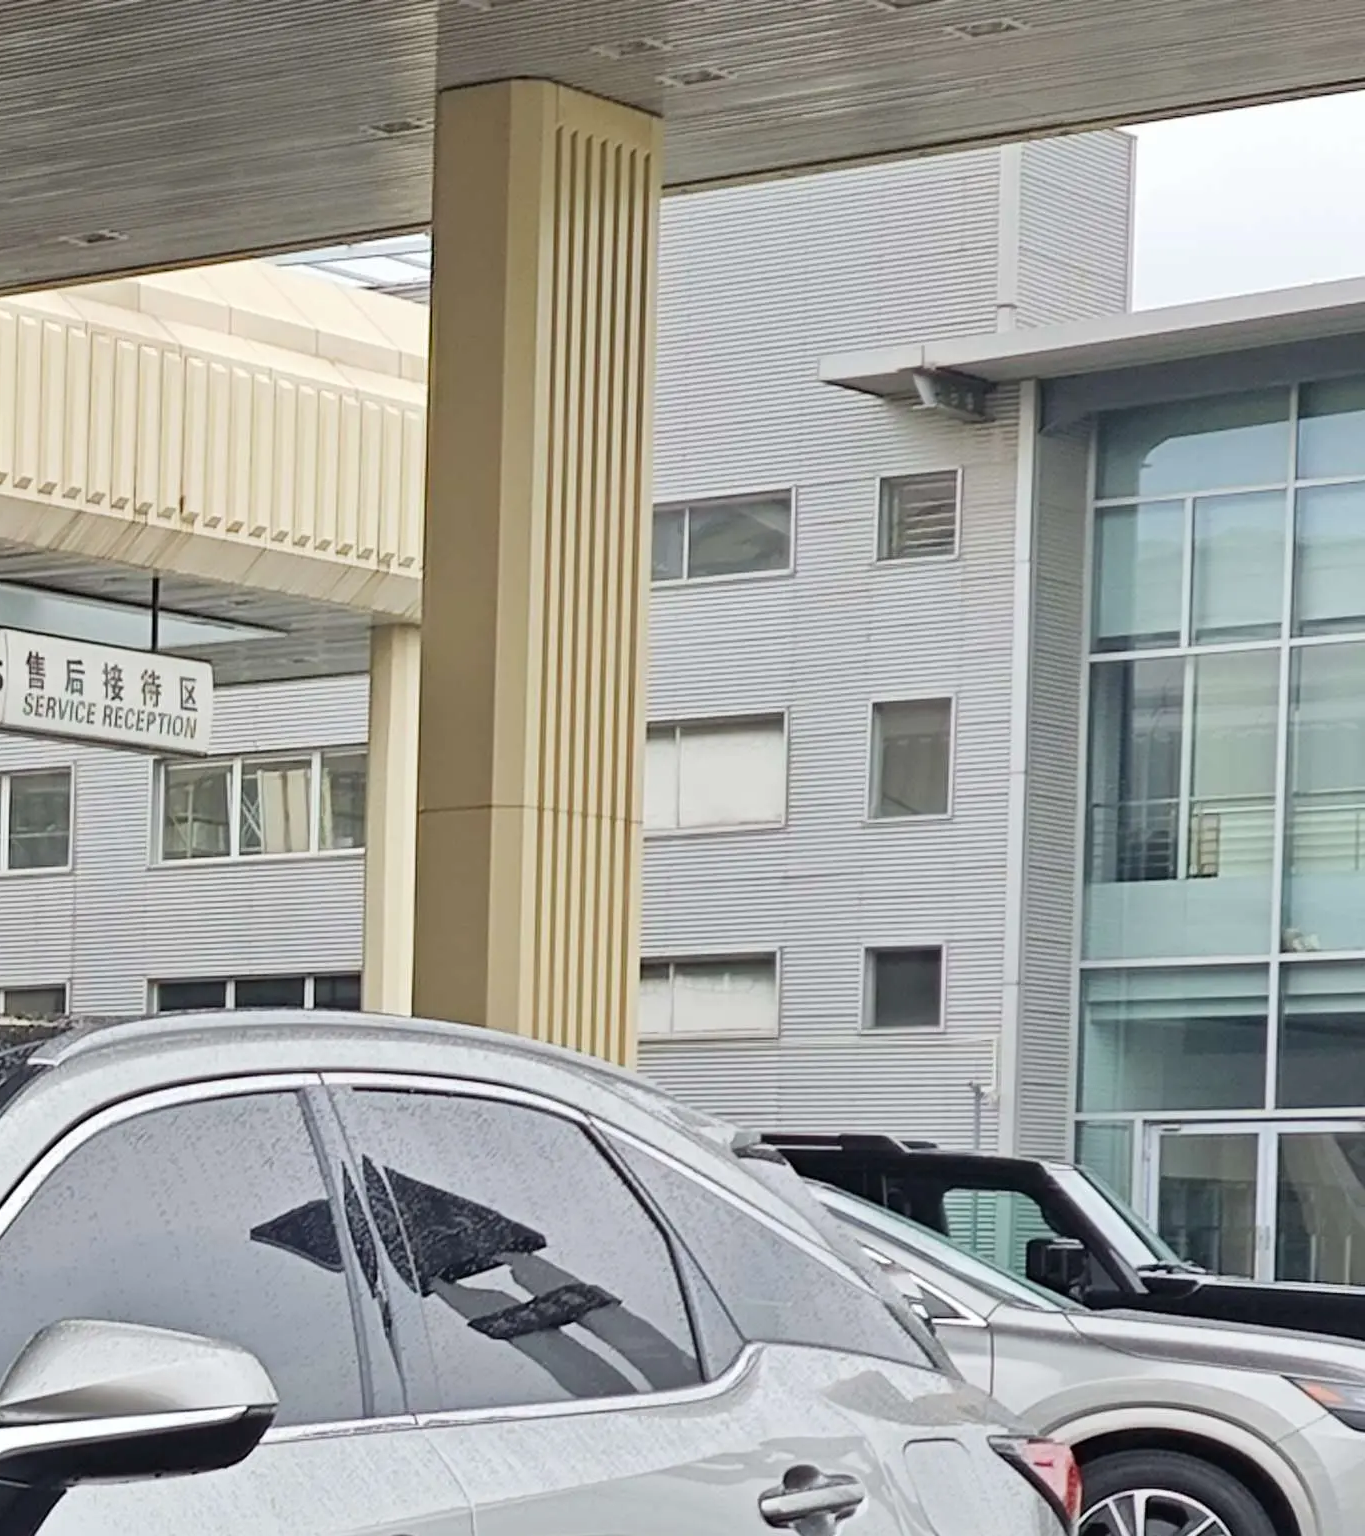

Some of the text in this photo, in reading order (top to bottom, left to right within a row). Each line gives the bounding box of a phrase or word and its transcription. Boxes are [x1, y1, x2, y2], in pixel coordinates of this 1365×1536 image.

[24, 650, 199, 713] 售后接待区
[22, 692, 198, 740] SERVICE RECEPTION
